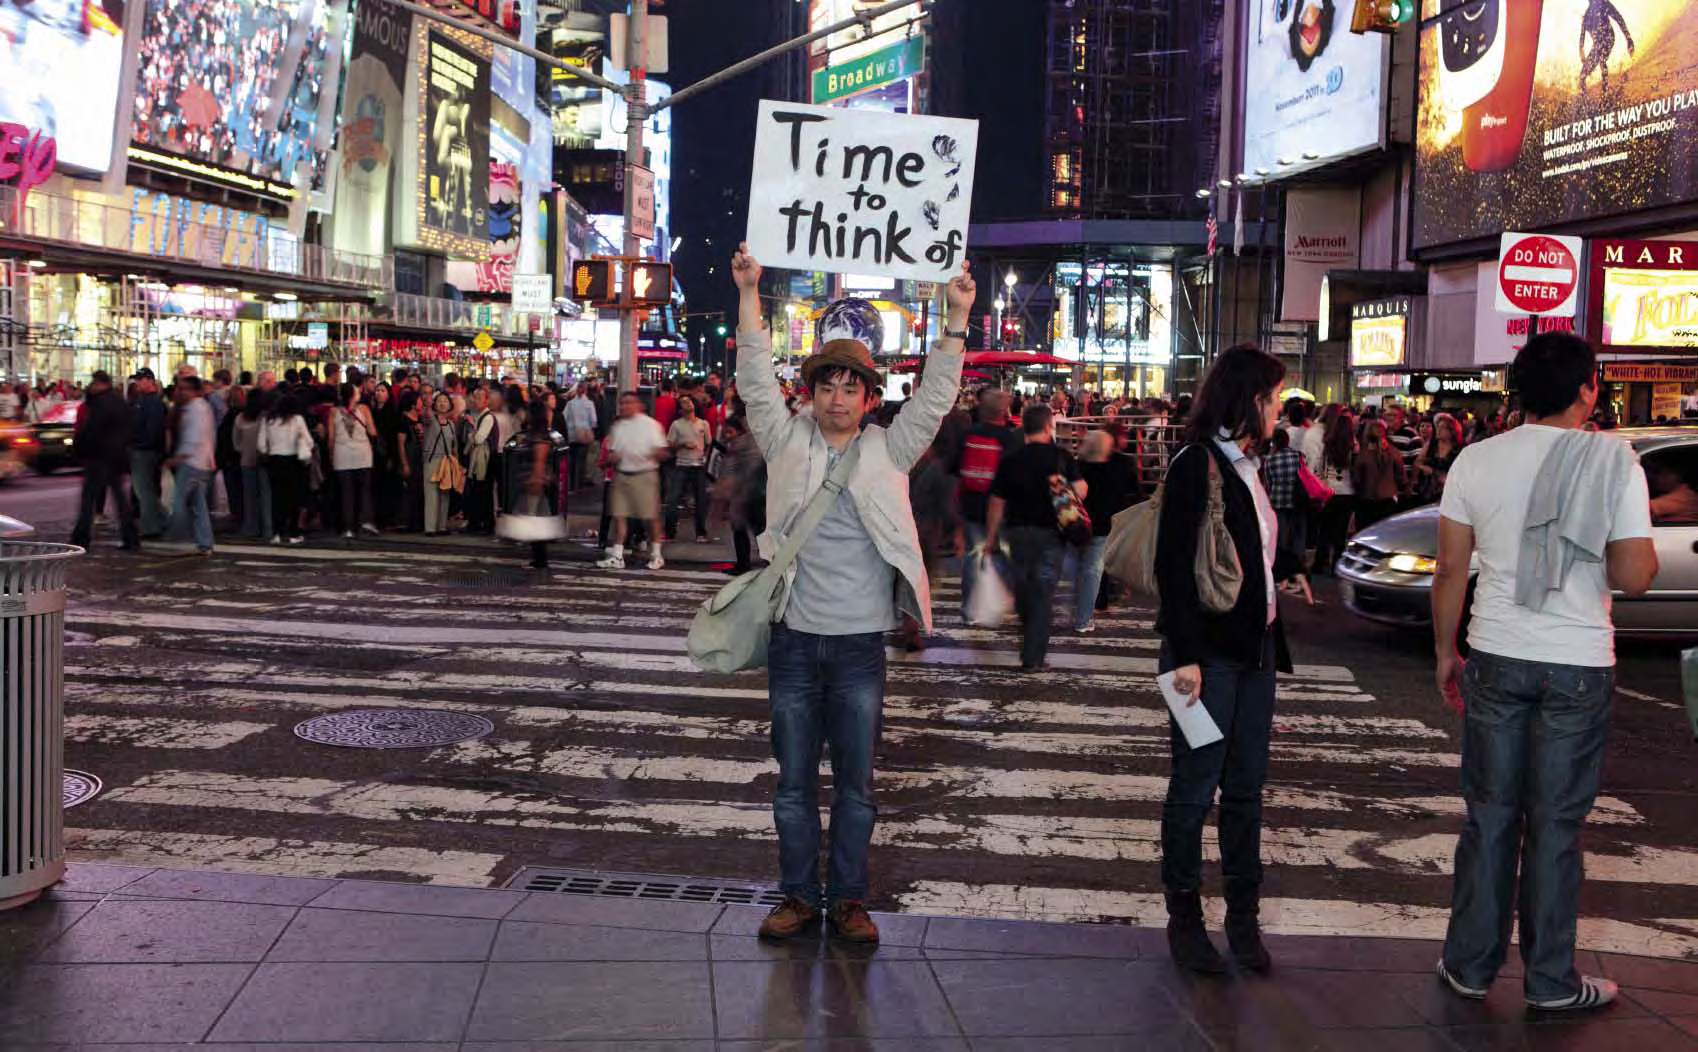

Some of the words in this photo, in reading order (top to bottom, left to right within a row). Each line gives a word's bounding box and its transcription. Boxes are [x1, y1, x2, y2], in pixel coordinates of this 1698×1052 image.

[1544, 124, 1570, 146] BUILT
[1572, 119, 1592, 138] FOR
[1594, 113, 1615, 132] THE
[1617, 104, 1644, 125] WAY
[1645, 98, 1671, 118] YOU
[772, 111, 926, 187] Time
[846, 184, 887, 211] to
[779, 200, 917, 264] think
[924, 229, 962, 271] of
[1293, 235, 1347, 248] Marriott
[1514, 249, 1533, 263] DO
[1538, 251, 1566, 265] NOT
[521, 289, 541, 298] MUST
[1514, 284, 1559, 299] ENTER
[1352, 300, 1408, 318] MARQUIS
